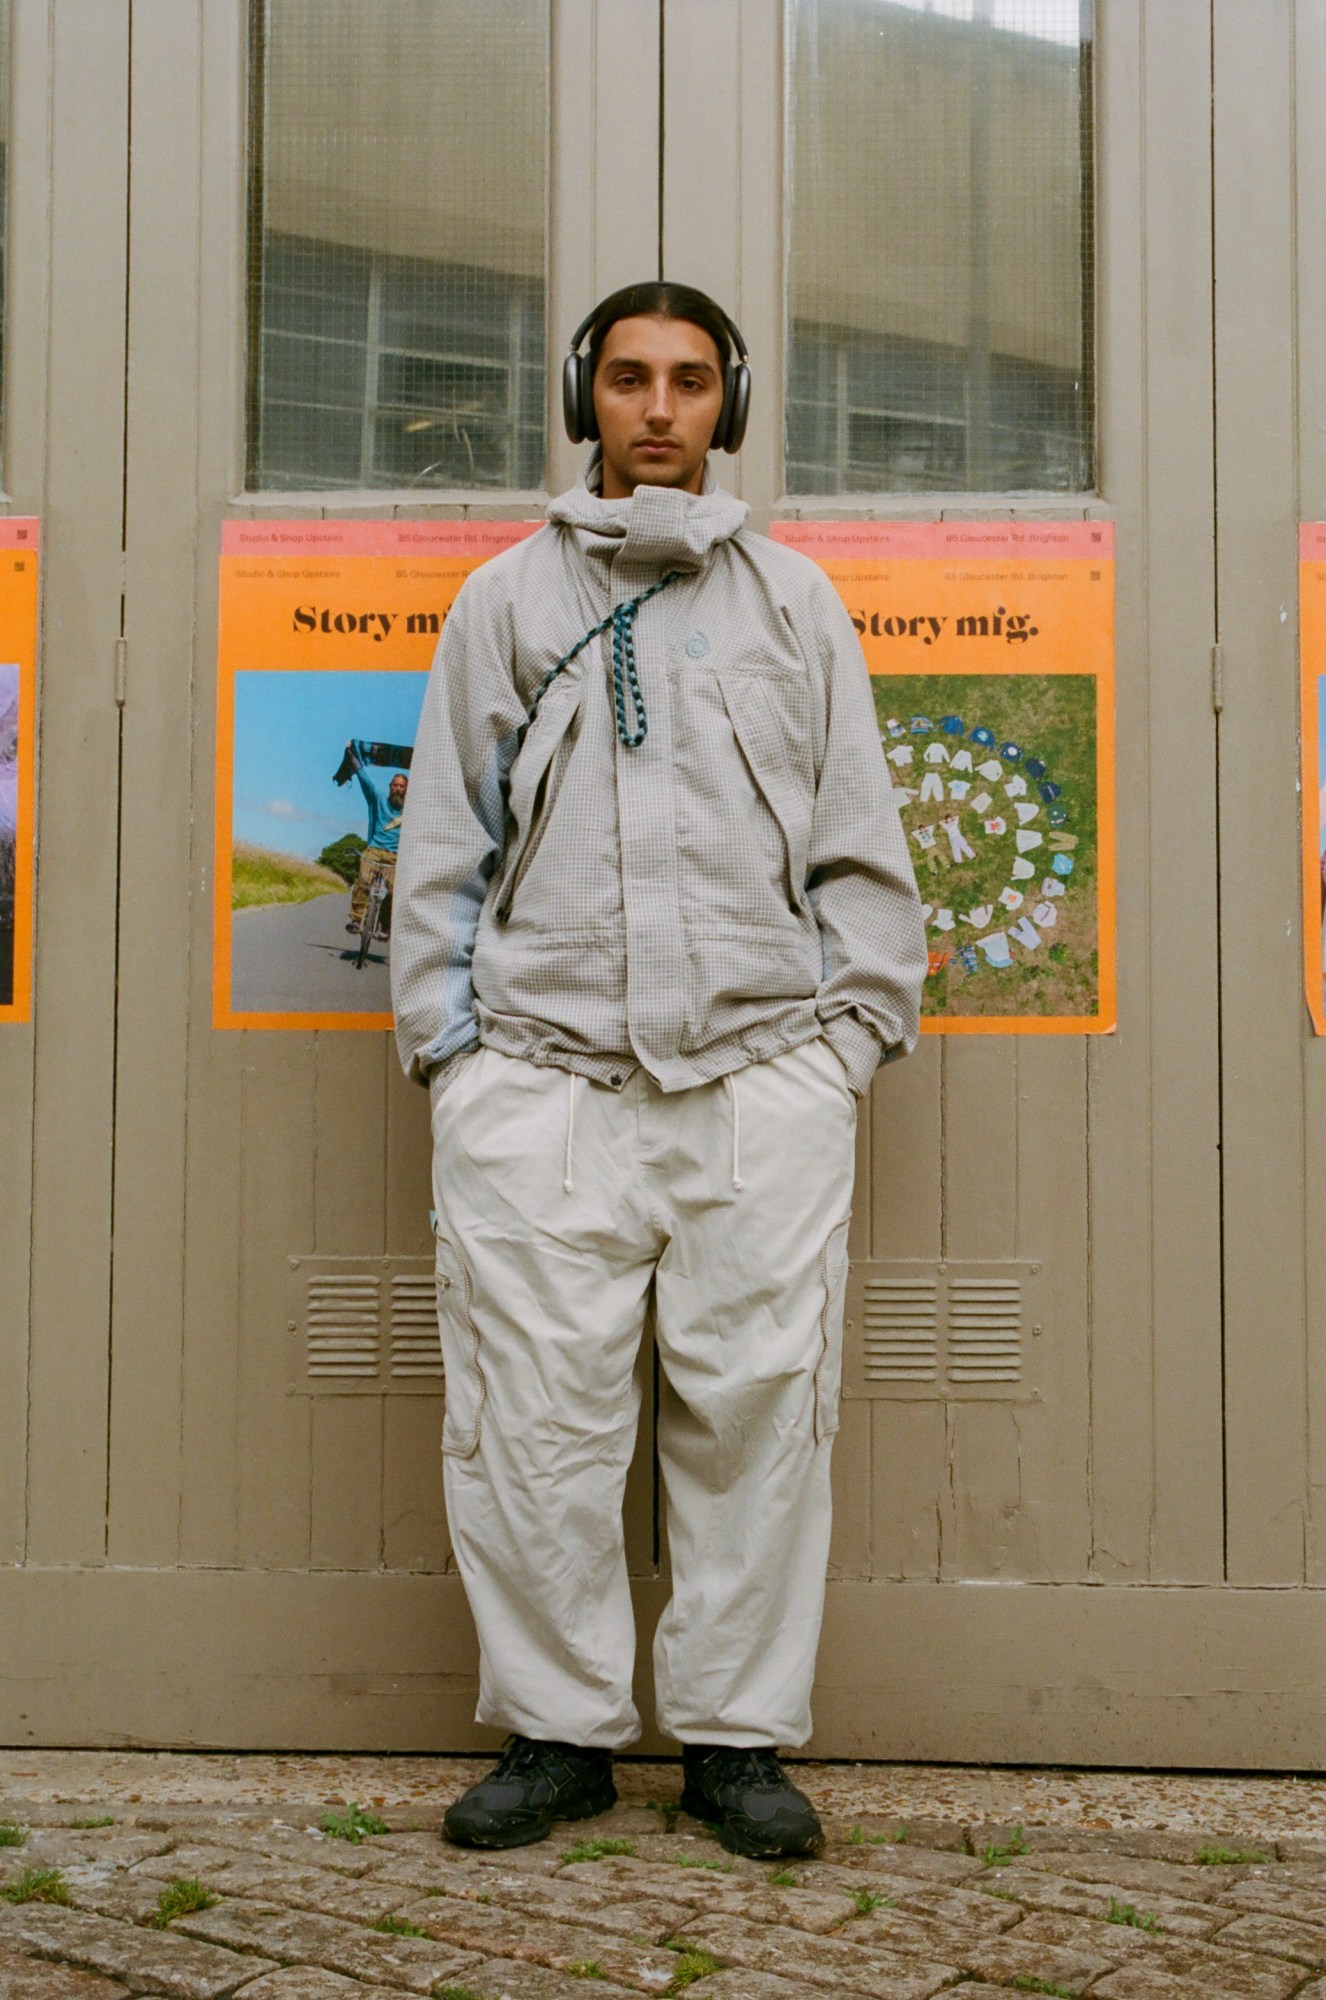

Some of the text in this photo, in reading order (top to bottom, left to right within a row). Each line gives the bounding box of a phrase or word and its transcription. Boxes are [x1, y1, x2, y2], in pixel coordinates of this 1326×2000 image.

[239, 533, 344, 544] Studio & Shop Upstairs
[413, 533, 461, 543] Gloucester
[482, 533, 521, 545] Brighton
[785, 534, 890, 545] Studio & Shop Upstairs
[959, 533, 1009, 543] Gloucester
[1029, 533, 1069, 544] Brighton
[235, 569, 340, 580] Studio & Shop Upstairs
[410, 569, 459, 579] Gloucester
[830, 573, 890, 582] hop Upstairs
[959, 572, 1008, 581] Gloucester
[1028, 572, 1068, 582] Brighton
[292, 604, 399, 642] Story
[848, 608, 947, 645] Story
